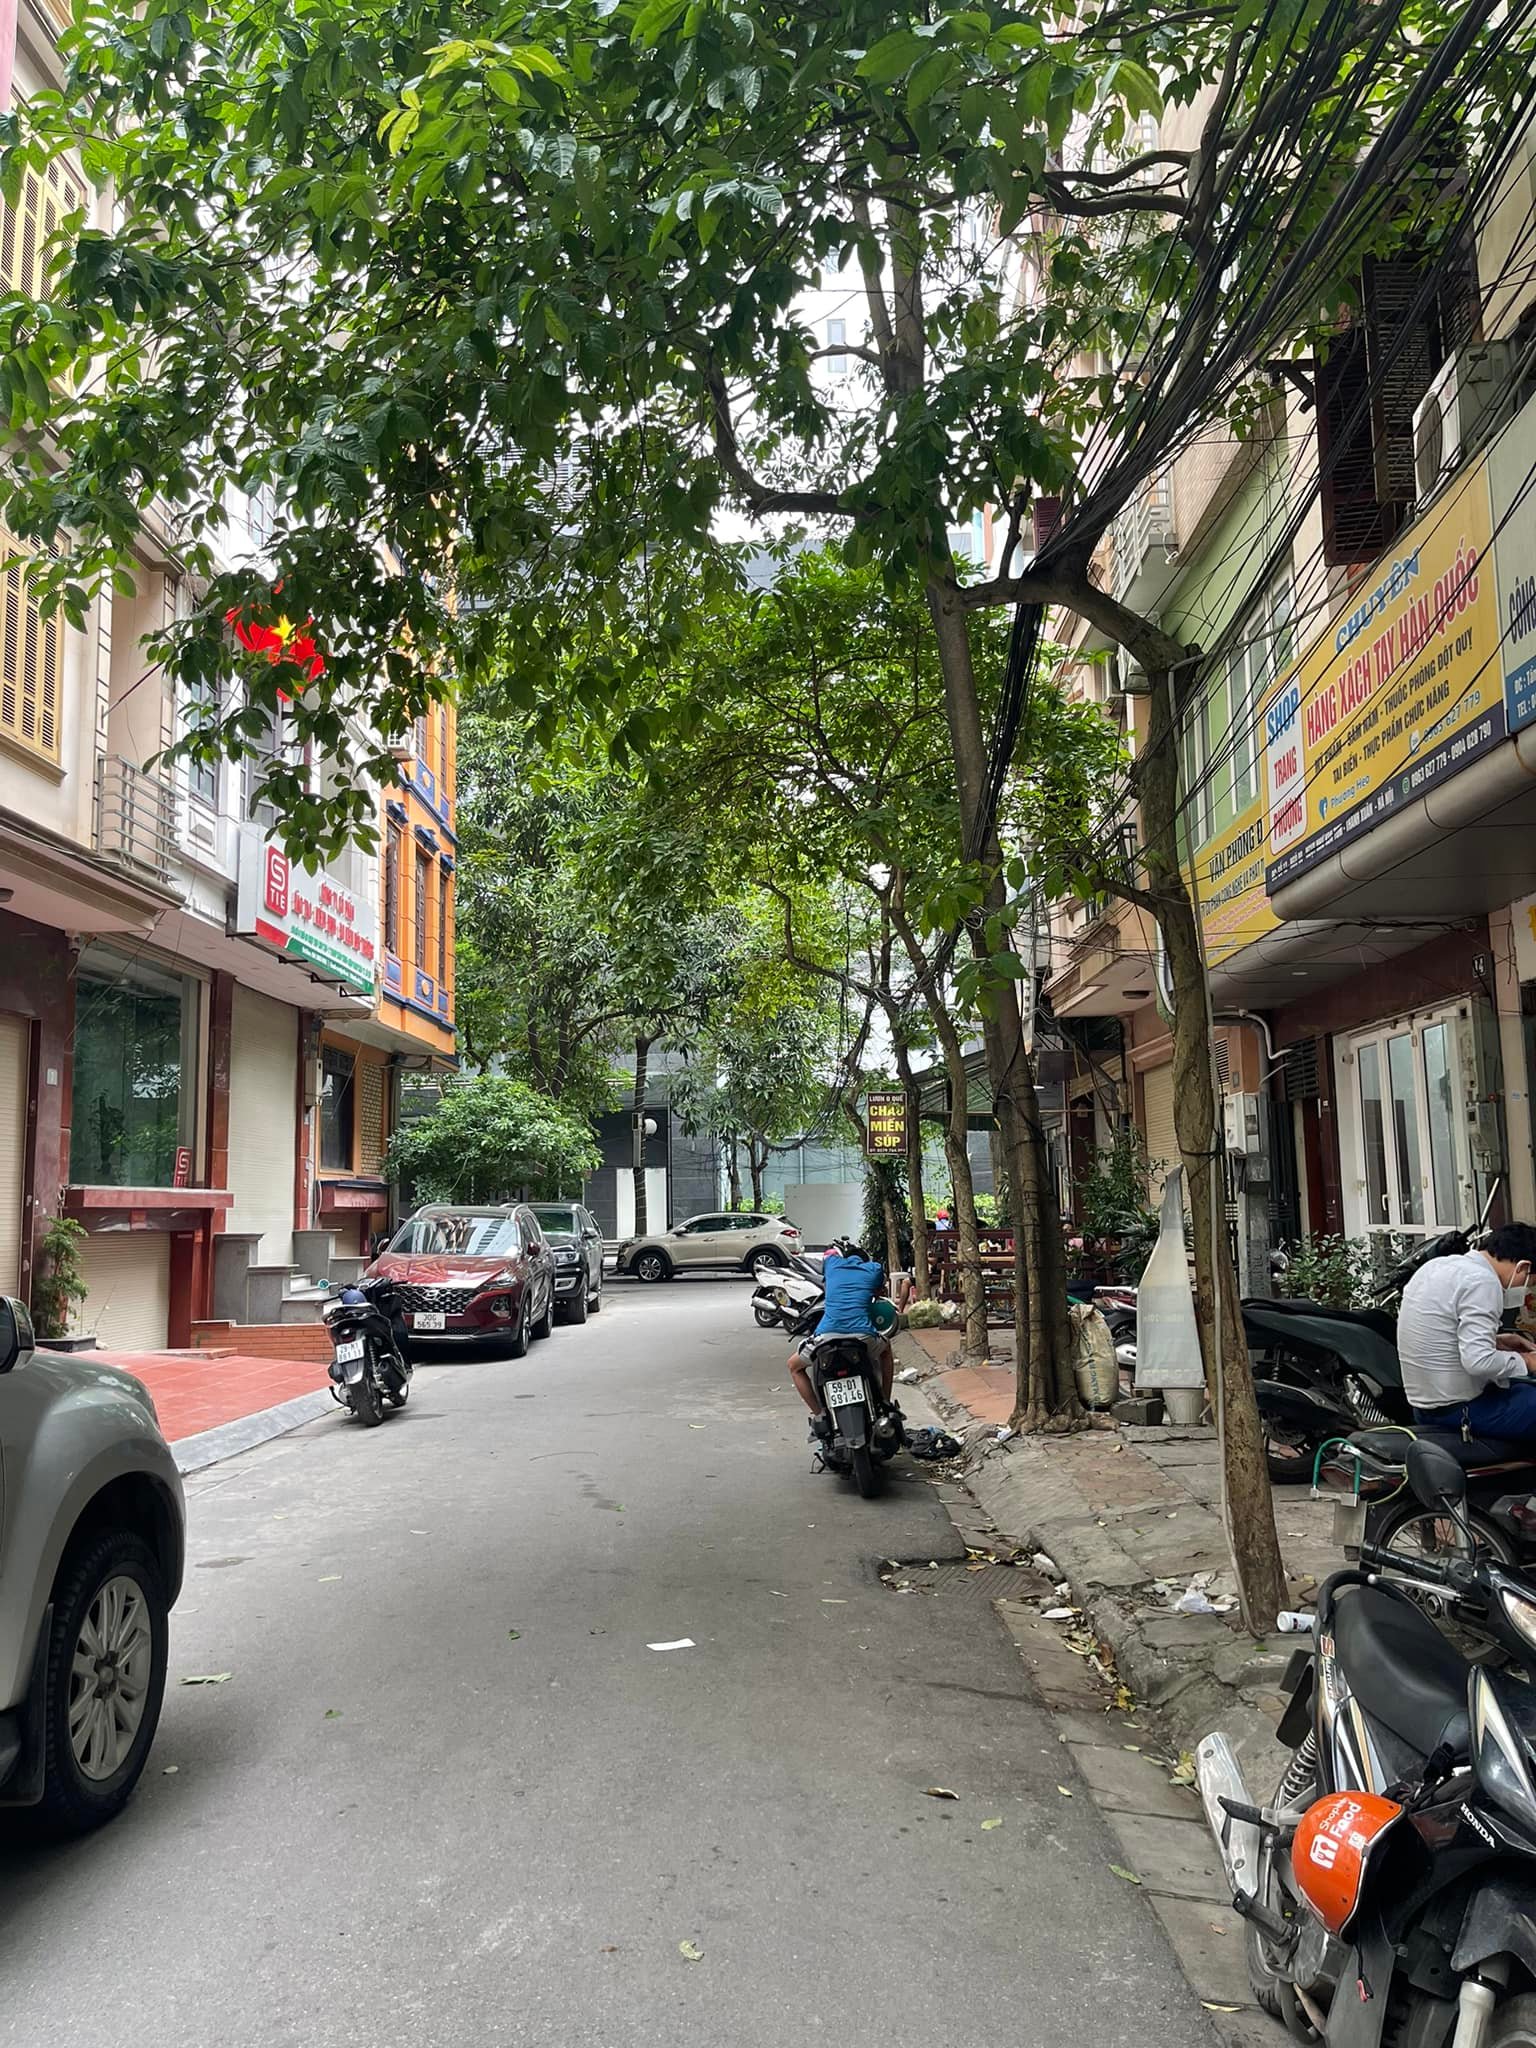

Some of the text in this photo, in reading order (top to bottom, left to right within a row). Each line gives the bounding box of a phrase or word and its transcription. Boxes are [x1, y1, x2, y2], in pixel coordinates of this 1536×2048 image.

[1336, 547, 1420, 654] CHUYÊN
[1307, 537, 1479, 748] HÀNG XÁCH TAY HÀN QUỐC
[1384, 682, 1408, 715] THUỐC
[1409, 660, 1436, 695] PHÒNG
[1437, 643, 1453, 672] ĐỘT
[1426, 680, 1449, 712] NĂNG
[1267, 688, 1298, 747] SHOP
[1464, 691, 1480, 712] 779
[1274, 746, 1297, 789] TRANG
[1227, 825, 1255, 869] PHÒNG
[271, 854, 286, 892] S
[270, 890, 286, 910] TIE
[874, 1134, 900, 1147] SÚP
[1461, 1802, 1495, 1848] HONDA
